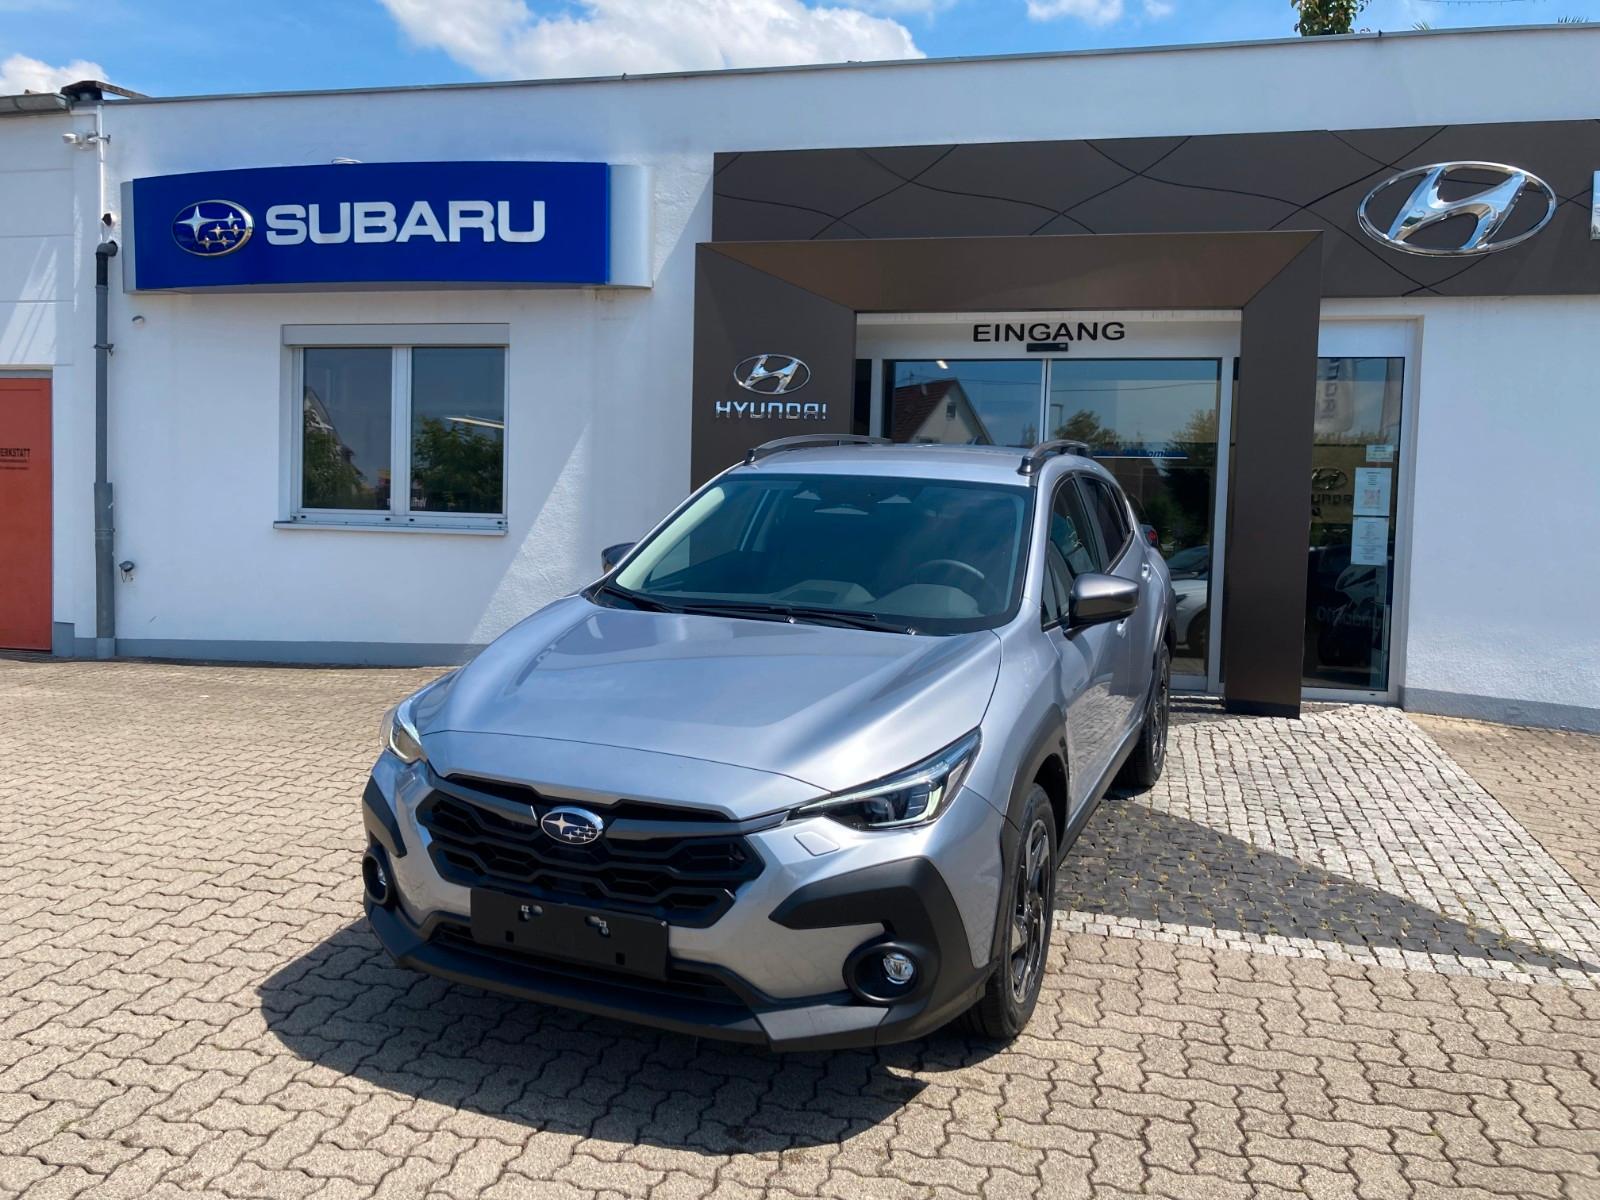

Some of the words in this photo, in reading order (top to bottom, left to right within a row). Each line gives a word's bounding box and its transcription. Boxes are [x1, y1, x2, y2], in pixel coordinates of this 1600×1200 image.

[266, 200, 546, 246] SUBARU
[972, 322, 1126, 342] EINGANG
[715, 401, 827, 419] HYUNDAI
